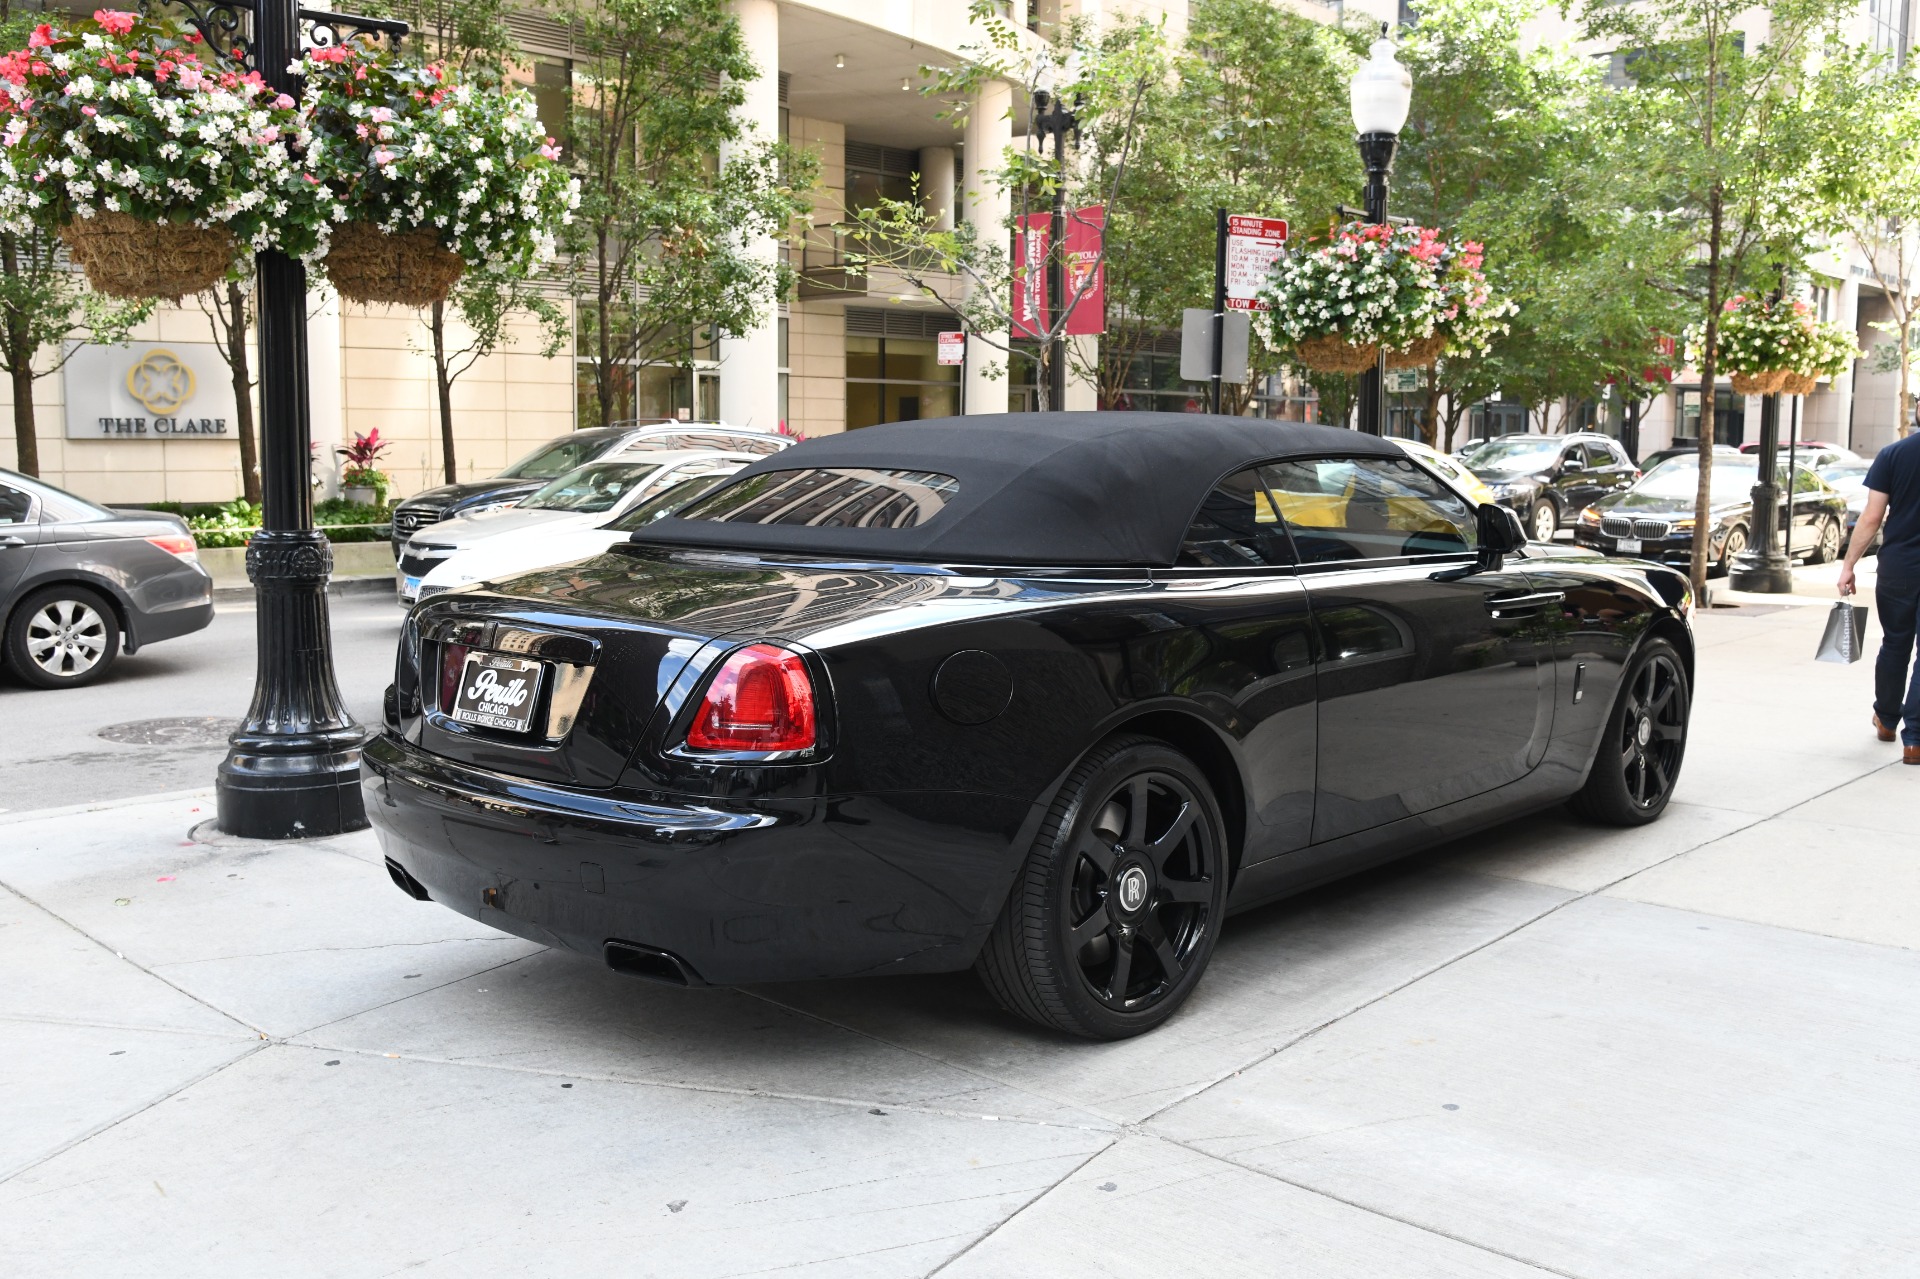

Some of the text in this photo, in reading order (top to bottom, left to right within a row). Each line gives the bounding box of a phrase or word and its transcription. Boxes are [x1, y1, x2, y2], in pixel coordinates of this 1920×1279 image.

[1240, 219, 1263, 229] MINUTE
[1232, 226, 1281, 238] STANDING ZONE
[1231, 239, 1244, 247] USE
[1069, 250, 1098, 260] YOLA
[1231, 246, 1283, 258] FLASHING LIGHTS
[1231, 262, 1245, 270] MON
[1231, 270, 1237, 278] 10
[1231, 277, 1241, 286] FRI
[1229, 298, 1272, 310] TOW ZON
[99, 417, 228, 434] THE CLARE
[467, 669, 528, 707] Perillo
[478, 701, 509, 716] CHICAGO
[461, 711, 516, 729] ROLLS ROYCE CHICAGO
